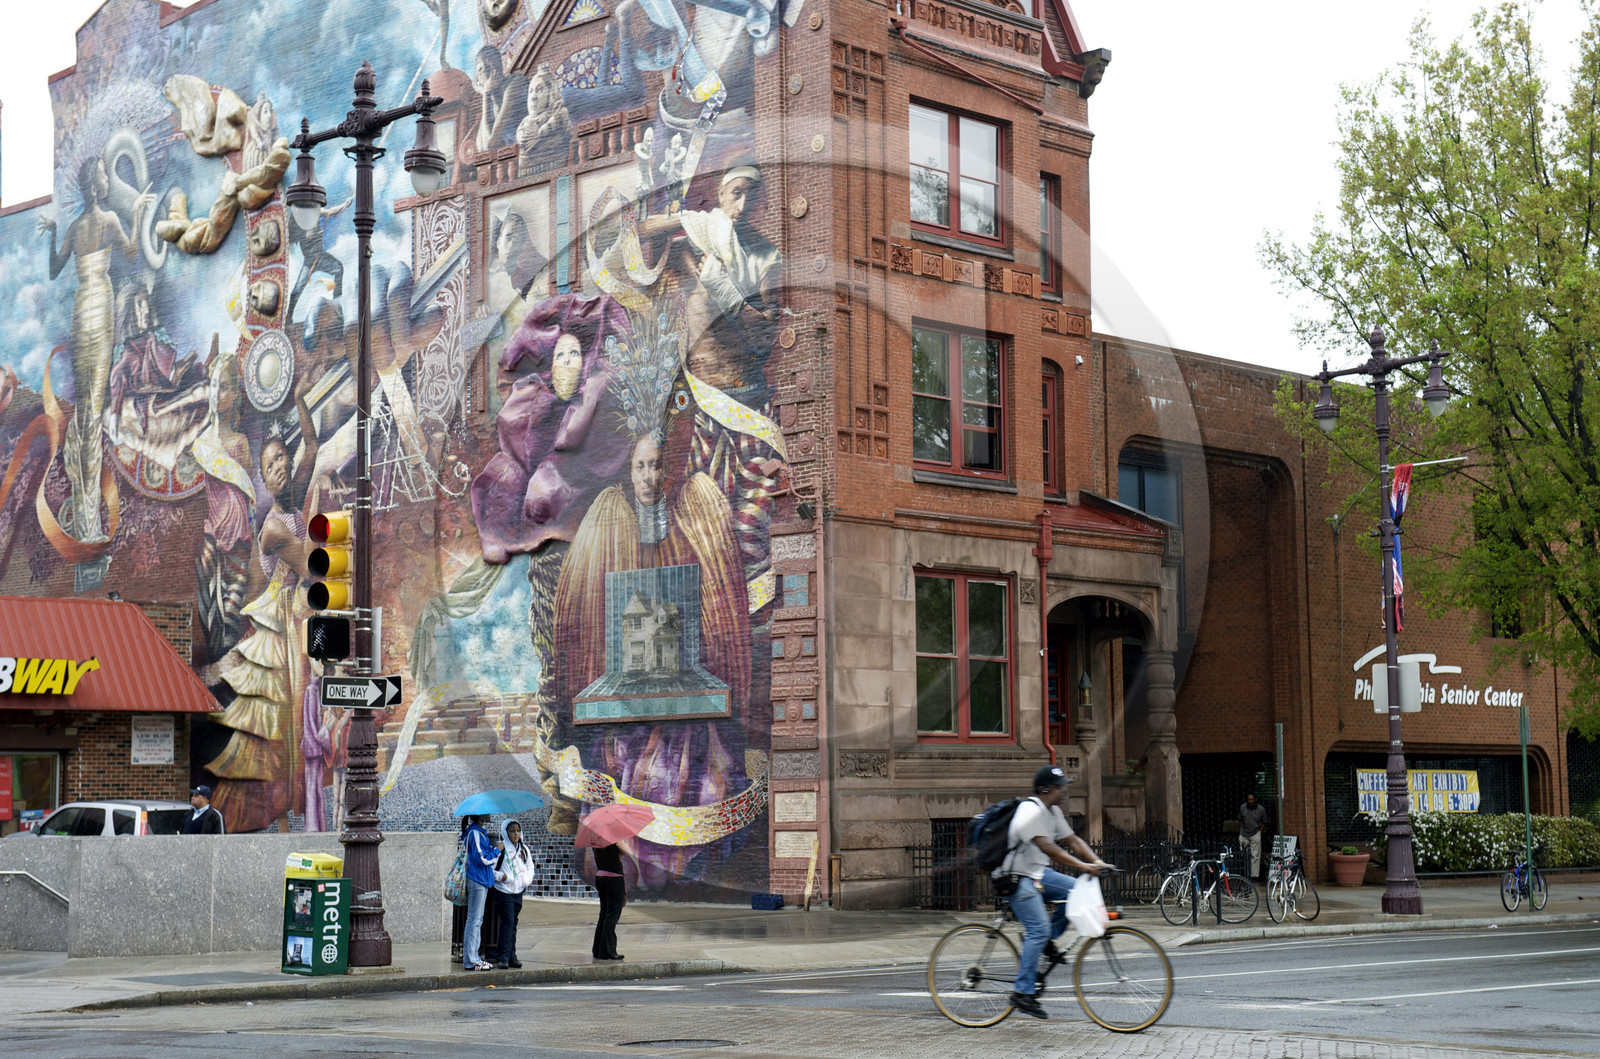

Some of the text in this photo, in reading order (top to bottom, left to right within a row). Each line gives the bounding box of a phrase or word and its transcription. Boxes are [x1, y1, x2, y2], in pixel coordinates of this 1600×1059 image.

[329, 686, 368, 698] ONE WAY
[1440, 683, 1480, 706] Senior
[1484, 686, 1523, 707] Center
[1358, 772, 1467, 791] COFFEE ART EXHIBIT
[1359, 793, 1379, 811] CITY
[1418, 793, 1429, 811] 14
[1433, 793, 1444, 811] 09
[321, 882, 342, 964] metro
